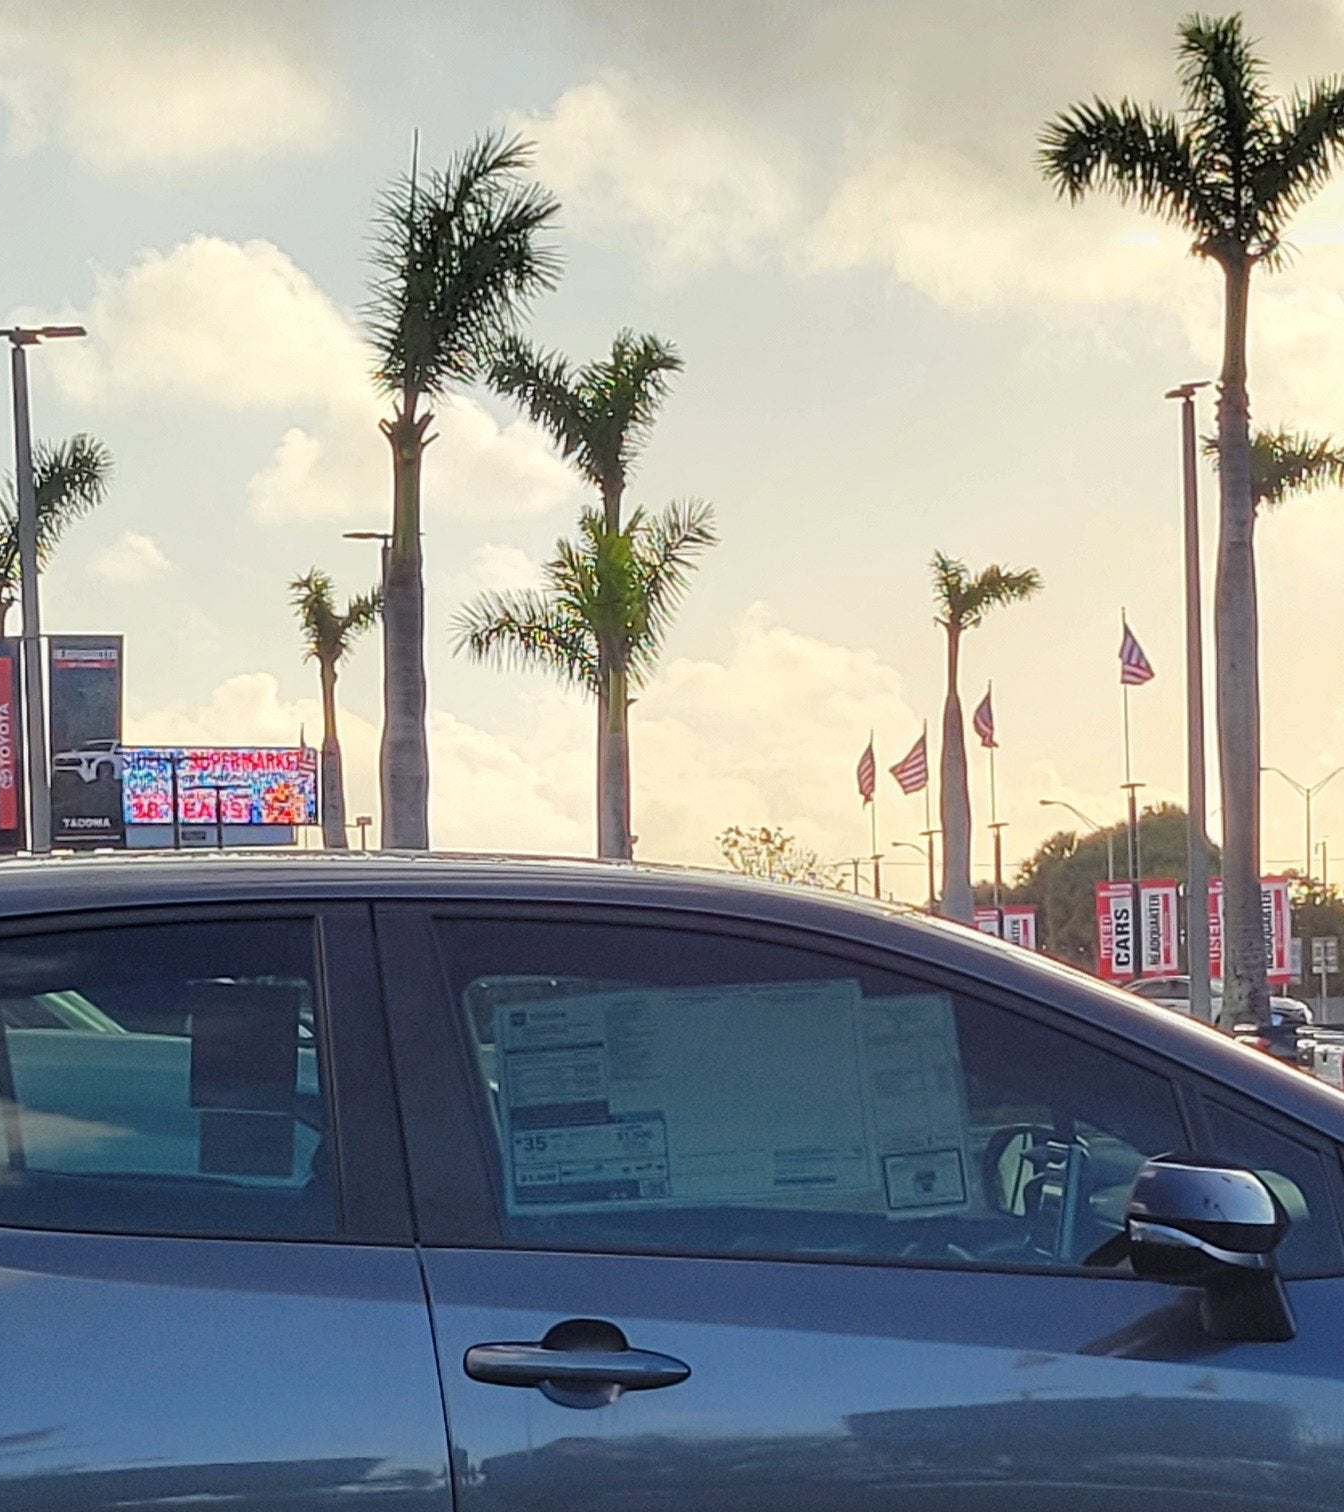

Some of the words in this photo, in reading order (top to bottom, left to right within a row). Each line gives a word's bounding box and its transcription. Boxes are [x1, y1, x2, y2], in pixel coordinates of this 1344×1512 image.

[1099, 916, 1113, 959] USED
[1114, 907, 1130, 966] CARS
[1209, 912, 1221, 960] USED
